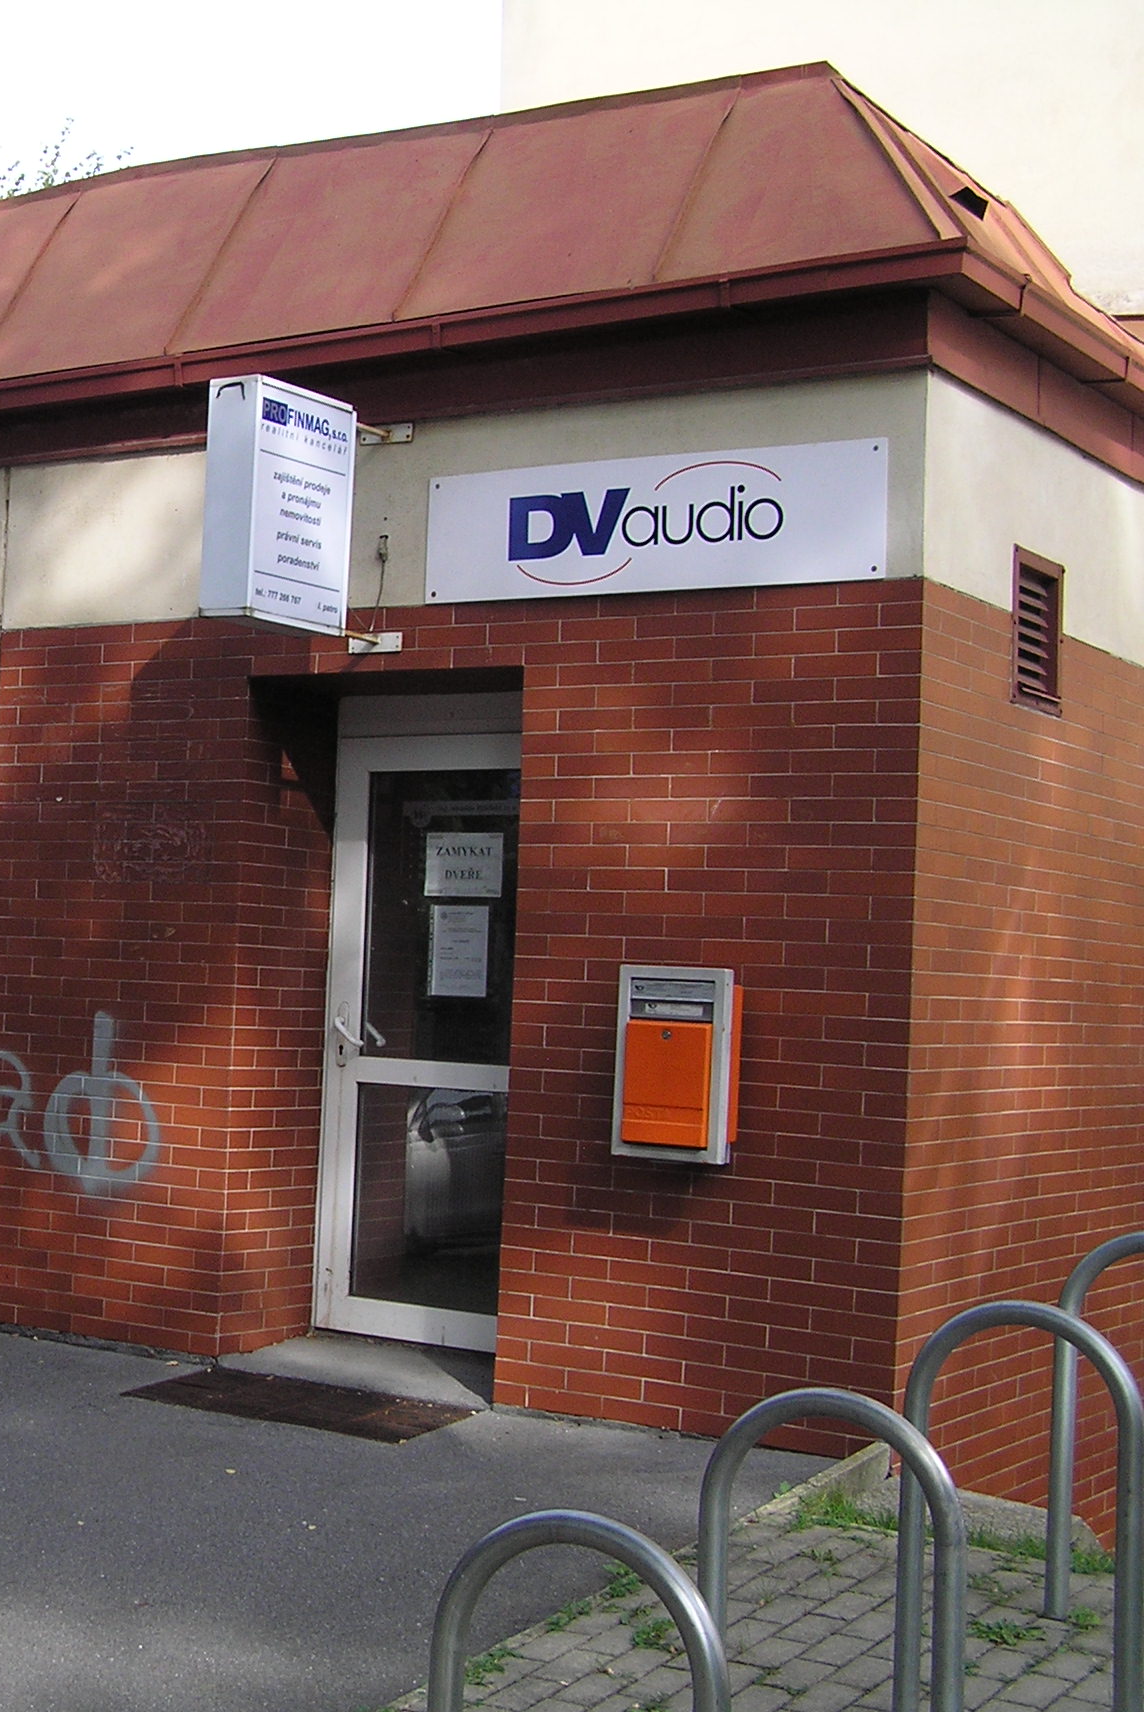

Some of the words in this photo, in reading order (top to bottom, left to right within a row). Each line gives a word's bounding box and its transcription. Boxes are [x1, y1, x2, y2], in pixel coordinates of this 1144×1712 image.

[274, 471, 303, 486] zajištění
[304, 479, 331, 496] prodeje
[281, 491, 286, 500] a
[287, 494, 322, 509] pronájmu
[280, 508, 321, 525] nemovitosti
[276, 530, 300, 545] právní
[301, 537, 322, 550] servis
[277, 554, 319, 570] poradenství
[436, 846, 492, 857] ZAMYKAT
[445, 867, 482, 880] DVEŘE
